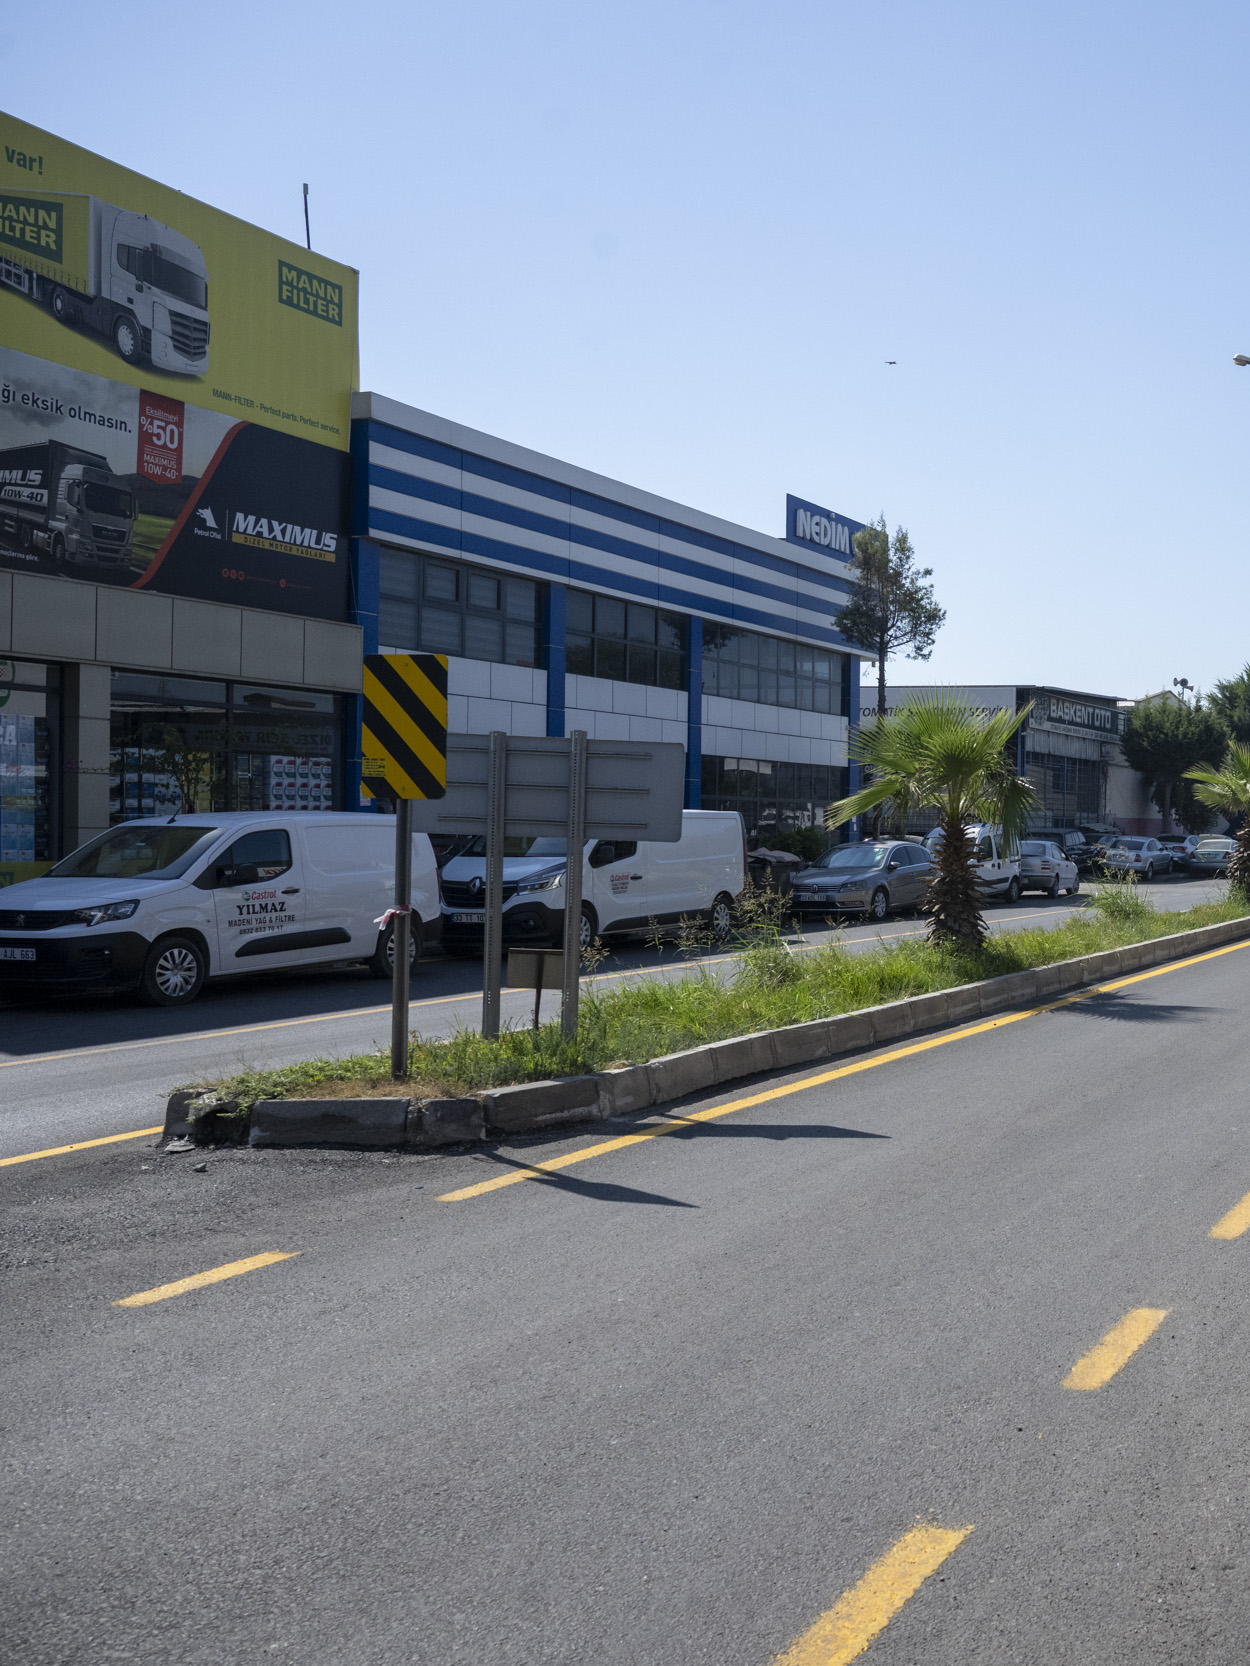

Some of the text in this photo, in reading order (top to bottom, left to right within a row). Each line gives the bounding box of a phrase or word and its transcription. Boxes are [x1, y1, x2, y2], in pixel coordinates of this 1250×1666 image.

[5, 145, 43, 176] var!
[0, 201, 57, 229] ANN
[282, 266, 339, 304] MANN
[282, 284, 340, 321] FILTER
[21, 392, 64, 415] eksik
[68, 405, 132, 433] olmasın.
[212, 388, 254, 408] MANN-FILTER
[260, 403, 281, 417] Perfect
[300, 415, 319, 429] Perfect
[144, 454, 177, 469] MAXIMUS
[4, 489, 44, 502] 10W-40
[194, 527, 209, 537] Petrol
[232, 512, 337, 552] MAXIMUS
[269, 541, 293, 553] MOTOR
[1051, 698, 1112, 729] BAŞKENT OTO
[251, 889, 277, 900] Castrol
[236, 902, 286, 915] YILMAZ
[228, 917, 253, 927] MADENİ
[254, 916, 267, 925] YAĞ
[275, 914, 295, 924] FİLTRE
[4, 949, 34, 960] AJL 663
